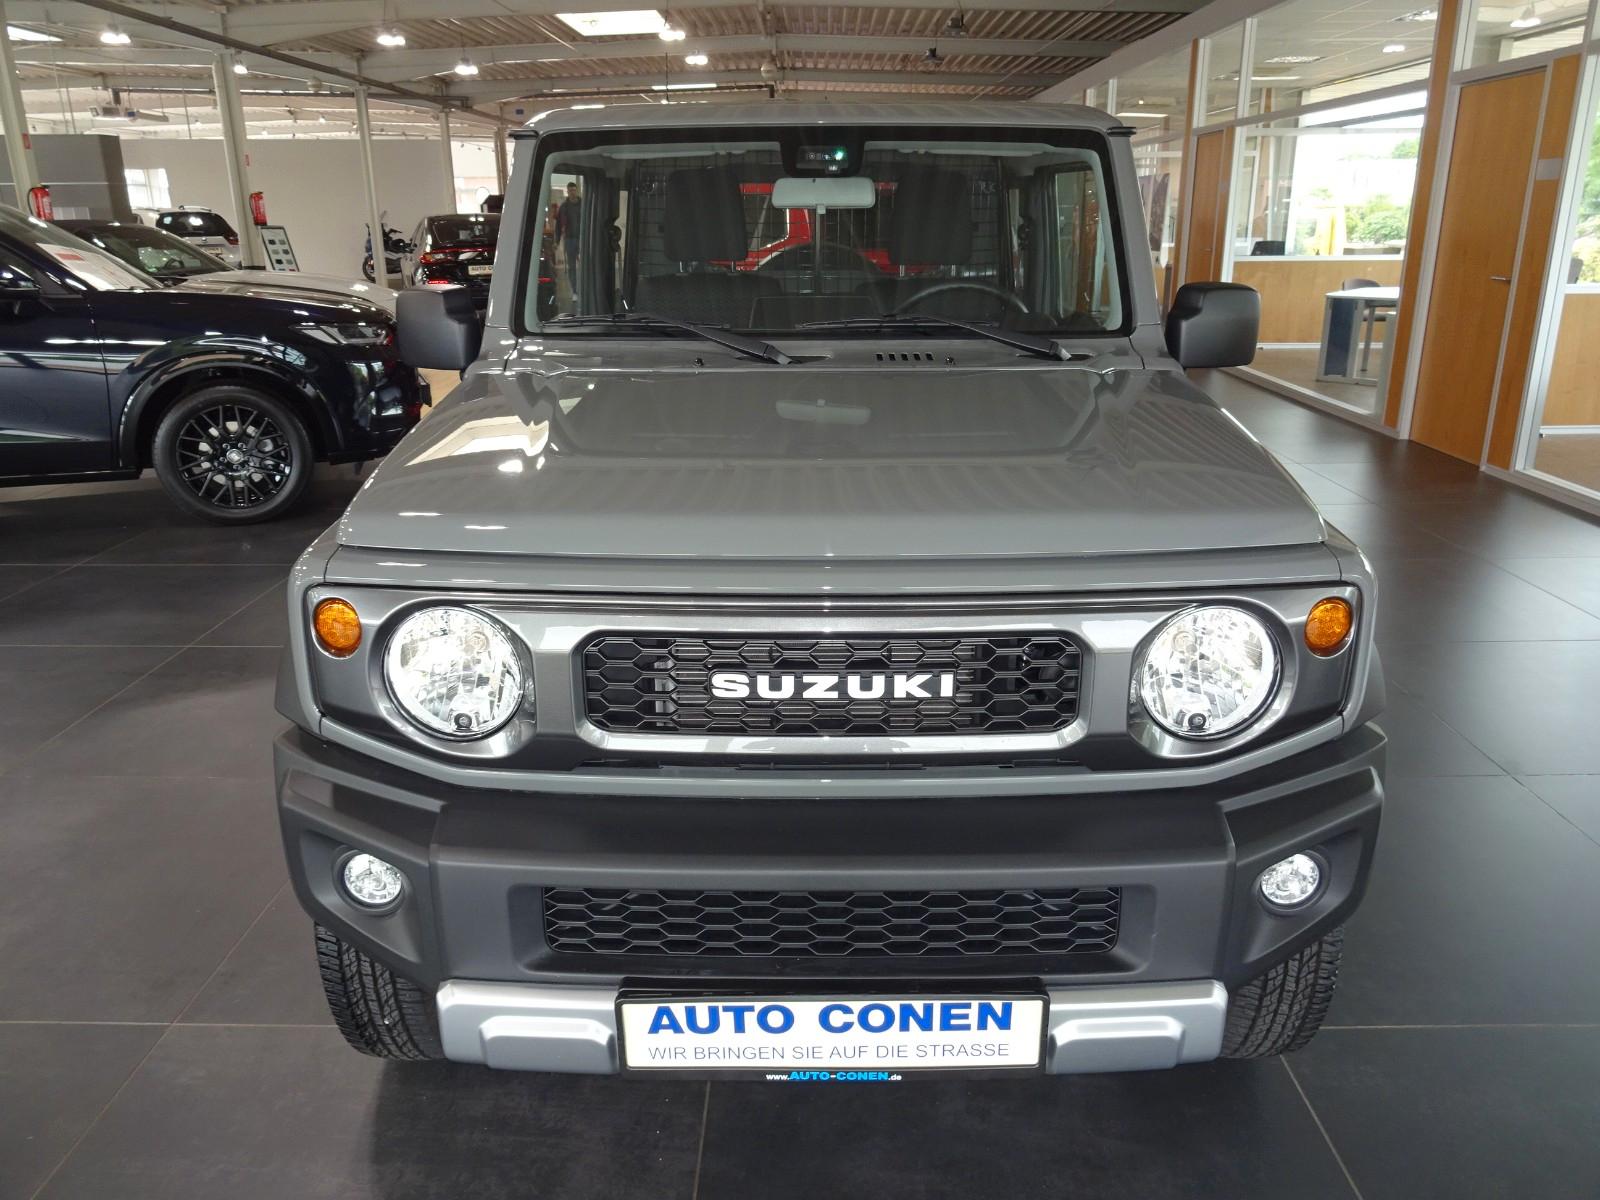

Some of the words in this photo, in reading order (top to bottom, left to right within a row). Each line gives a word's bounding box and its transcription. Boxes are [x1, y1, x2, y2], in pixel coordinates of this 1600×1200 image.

[711, 672, 955, 699] SUZUKI
[647, 1004, 795, 1035] AUTO
[818, 1001, 1013, 1034] CONEN
[648, 1046, 687, 1061] WIR
[694, 1046, 785, 1061] BRINGEN
[792, 1045, 824, 1060] SIE
[829, 1045, 869, 1060] AUF
[876, 1044, 909, 1058] DIE
[915, 1043, 1010, 1058] STRASSE
[766, 1071, 902, 1081] www.AUTO-CONEN.de
